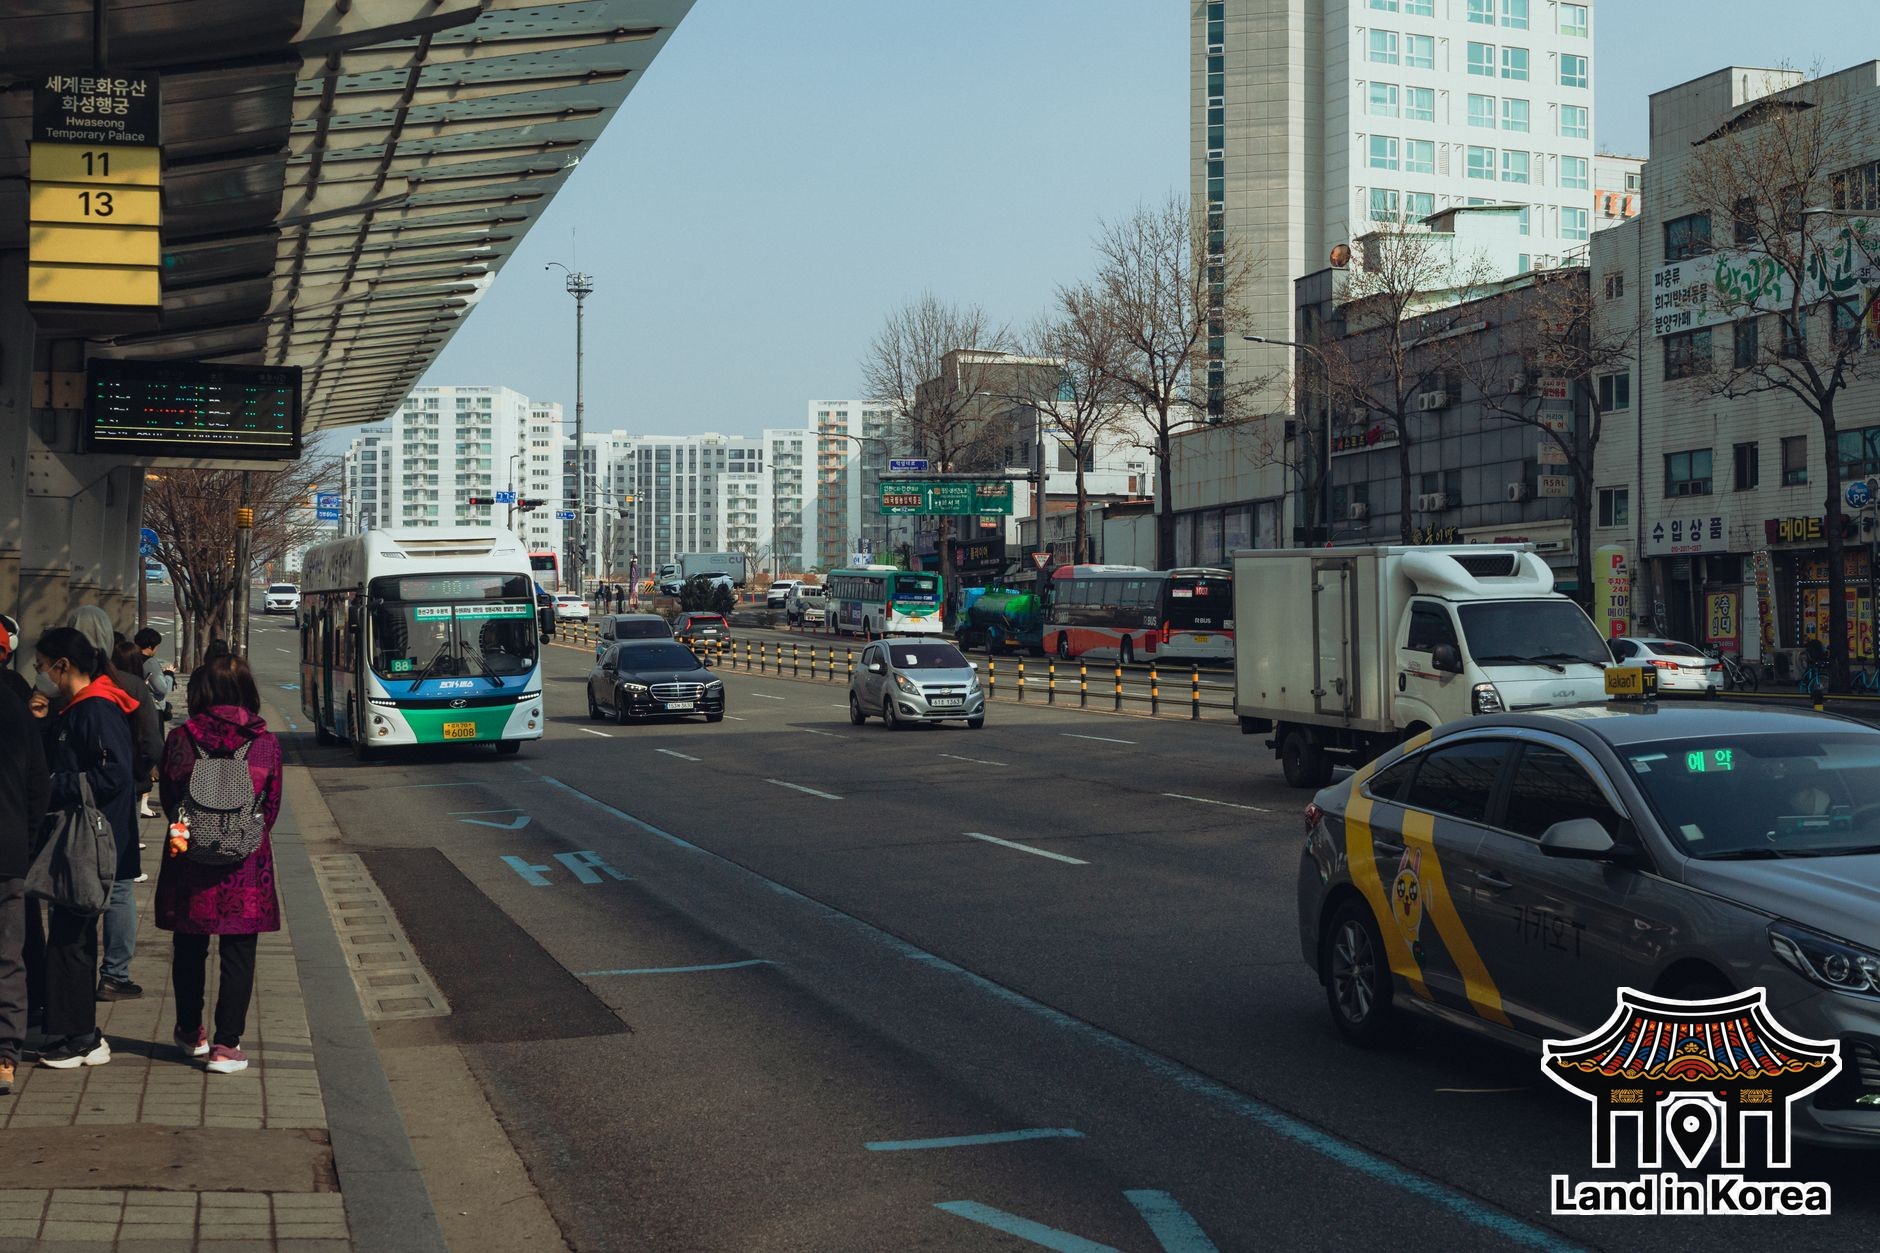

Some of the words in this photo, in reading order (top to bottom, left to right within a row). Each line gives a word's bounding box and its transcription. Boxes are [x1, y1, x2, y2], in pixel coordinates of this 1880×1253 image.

[45, 75, 147, 98] 세계문화유산
[62, 95, 130, 115] 화성행궁
[66, 116, 125, 131] Hwaseong
[46, 127, 106, 141] Temporary
[108, 130, 145, 142] Palace
[81, 151, 110, 177] 11
[78, 191, 114, 217] 13
[1654, 267, 1680, 289] 파충류
[1654, 310, 1691, 334] 분양카페
[1779, 517, 1821, 540] 메이드
[728, 556, 743, 564] CU
[394, 661, 409, 672] 88
[1608, 674, 1637, 688] kakaoT
